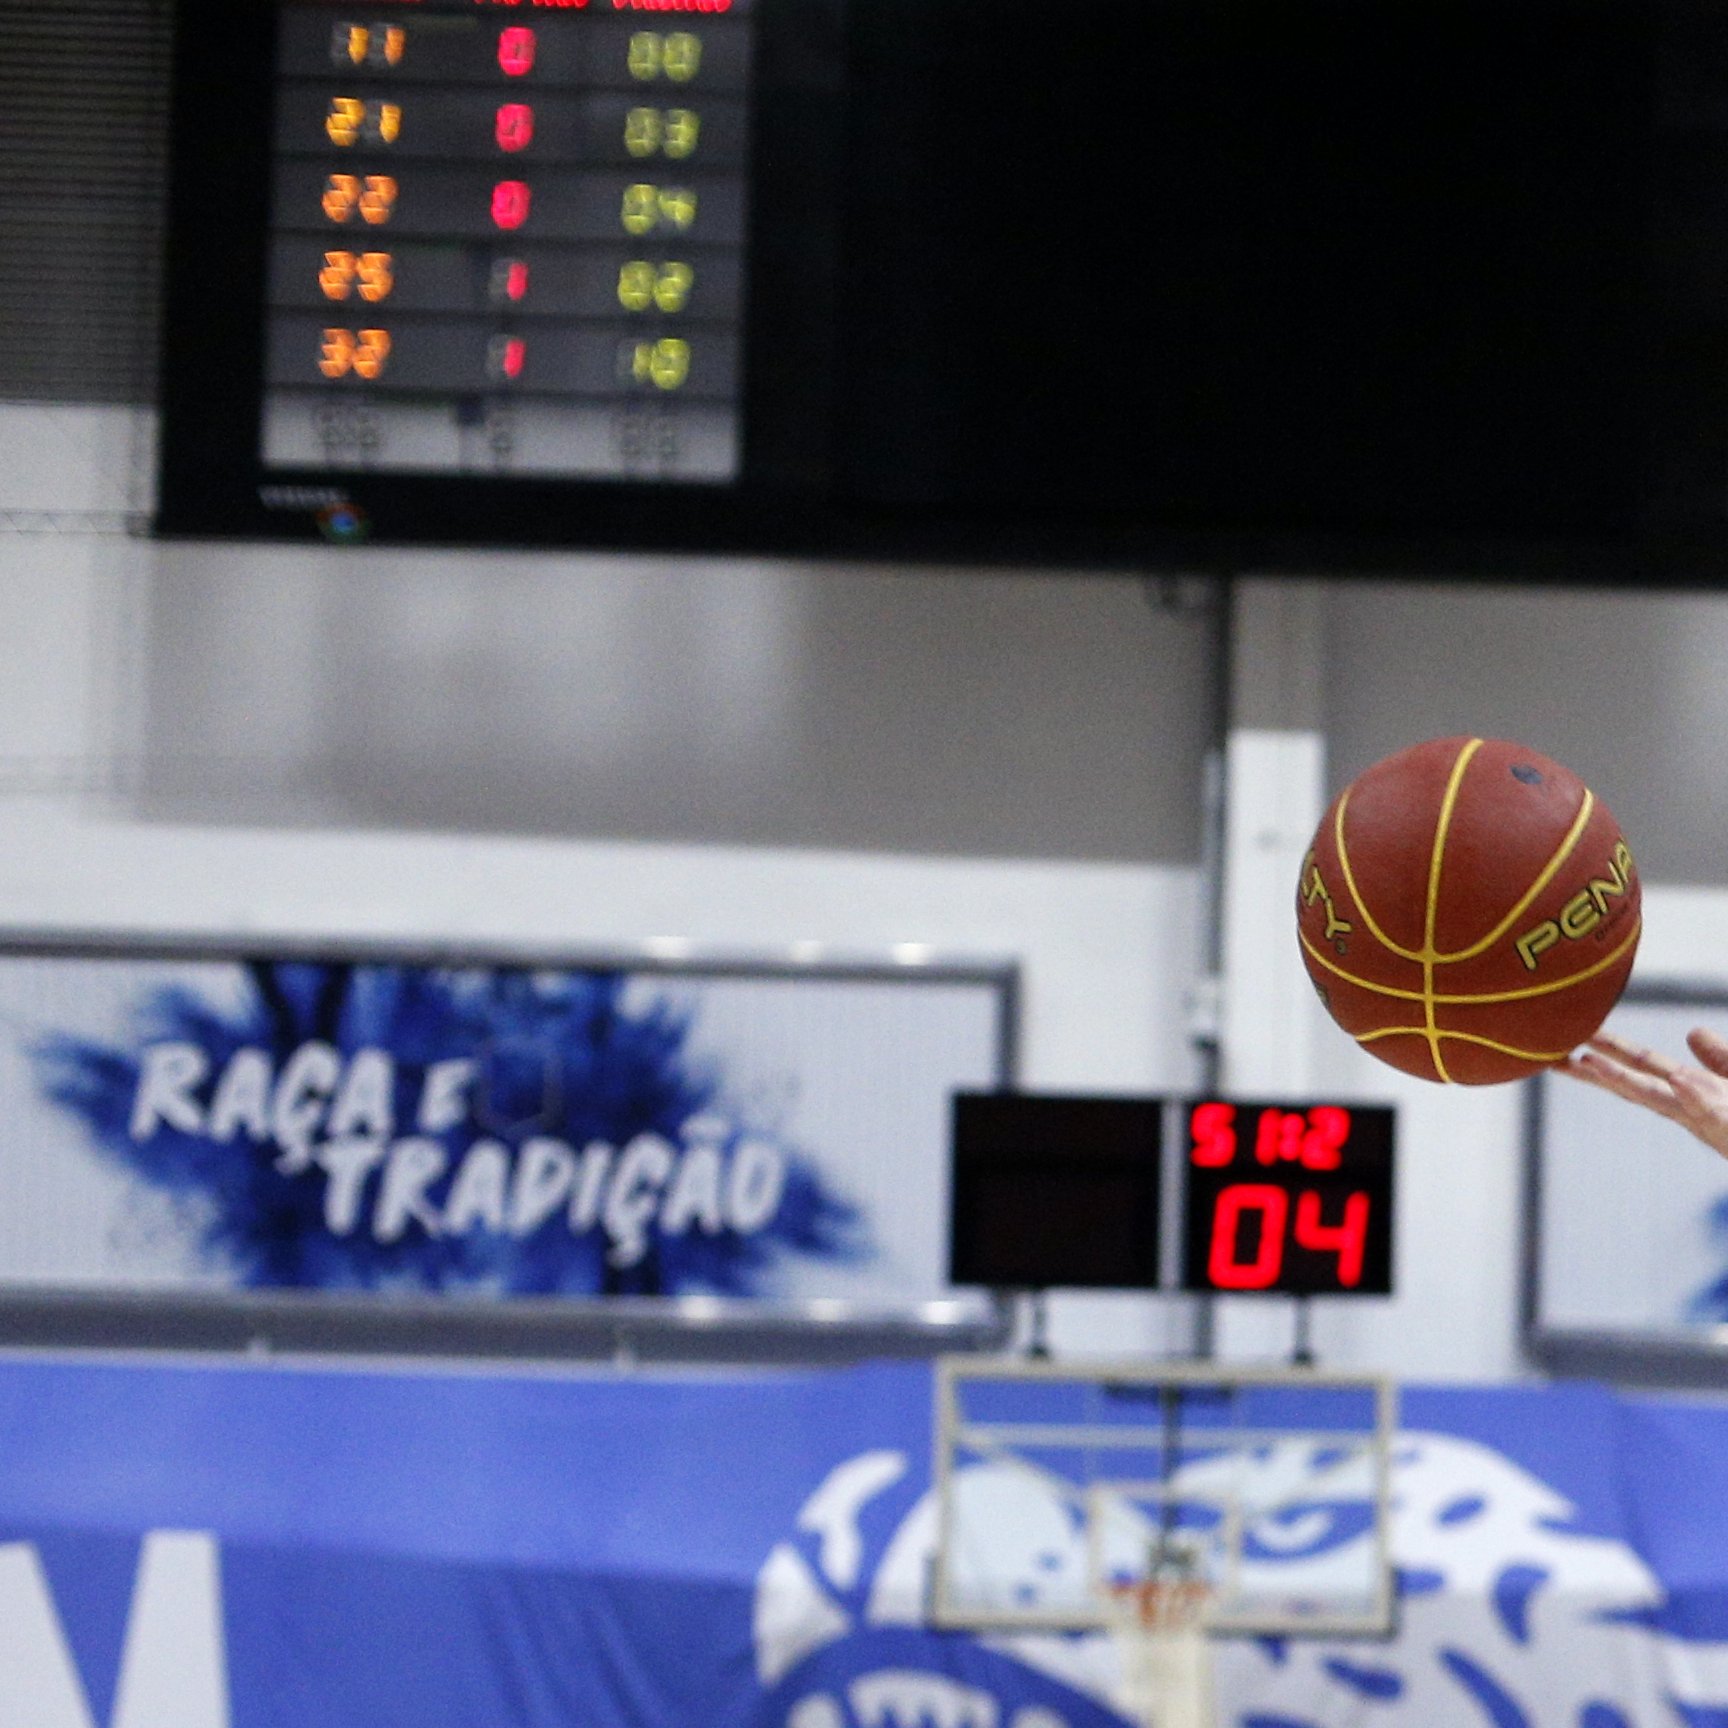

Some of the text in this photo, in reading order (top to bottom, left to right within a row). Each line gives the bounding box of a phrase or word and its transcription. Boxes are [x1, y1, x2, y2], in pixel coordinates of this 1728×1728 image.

[505, 262, 528, 300] 1
[503, 340, 526, 377] 1
[130, 1040, 478, 1177] RAÇA E
[319, 1112, 787, 1268] TRADIÇÃO
[1208, 1184, 1371, 1291] 04
